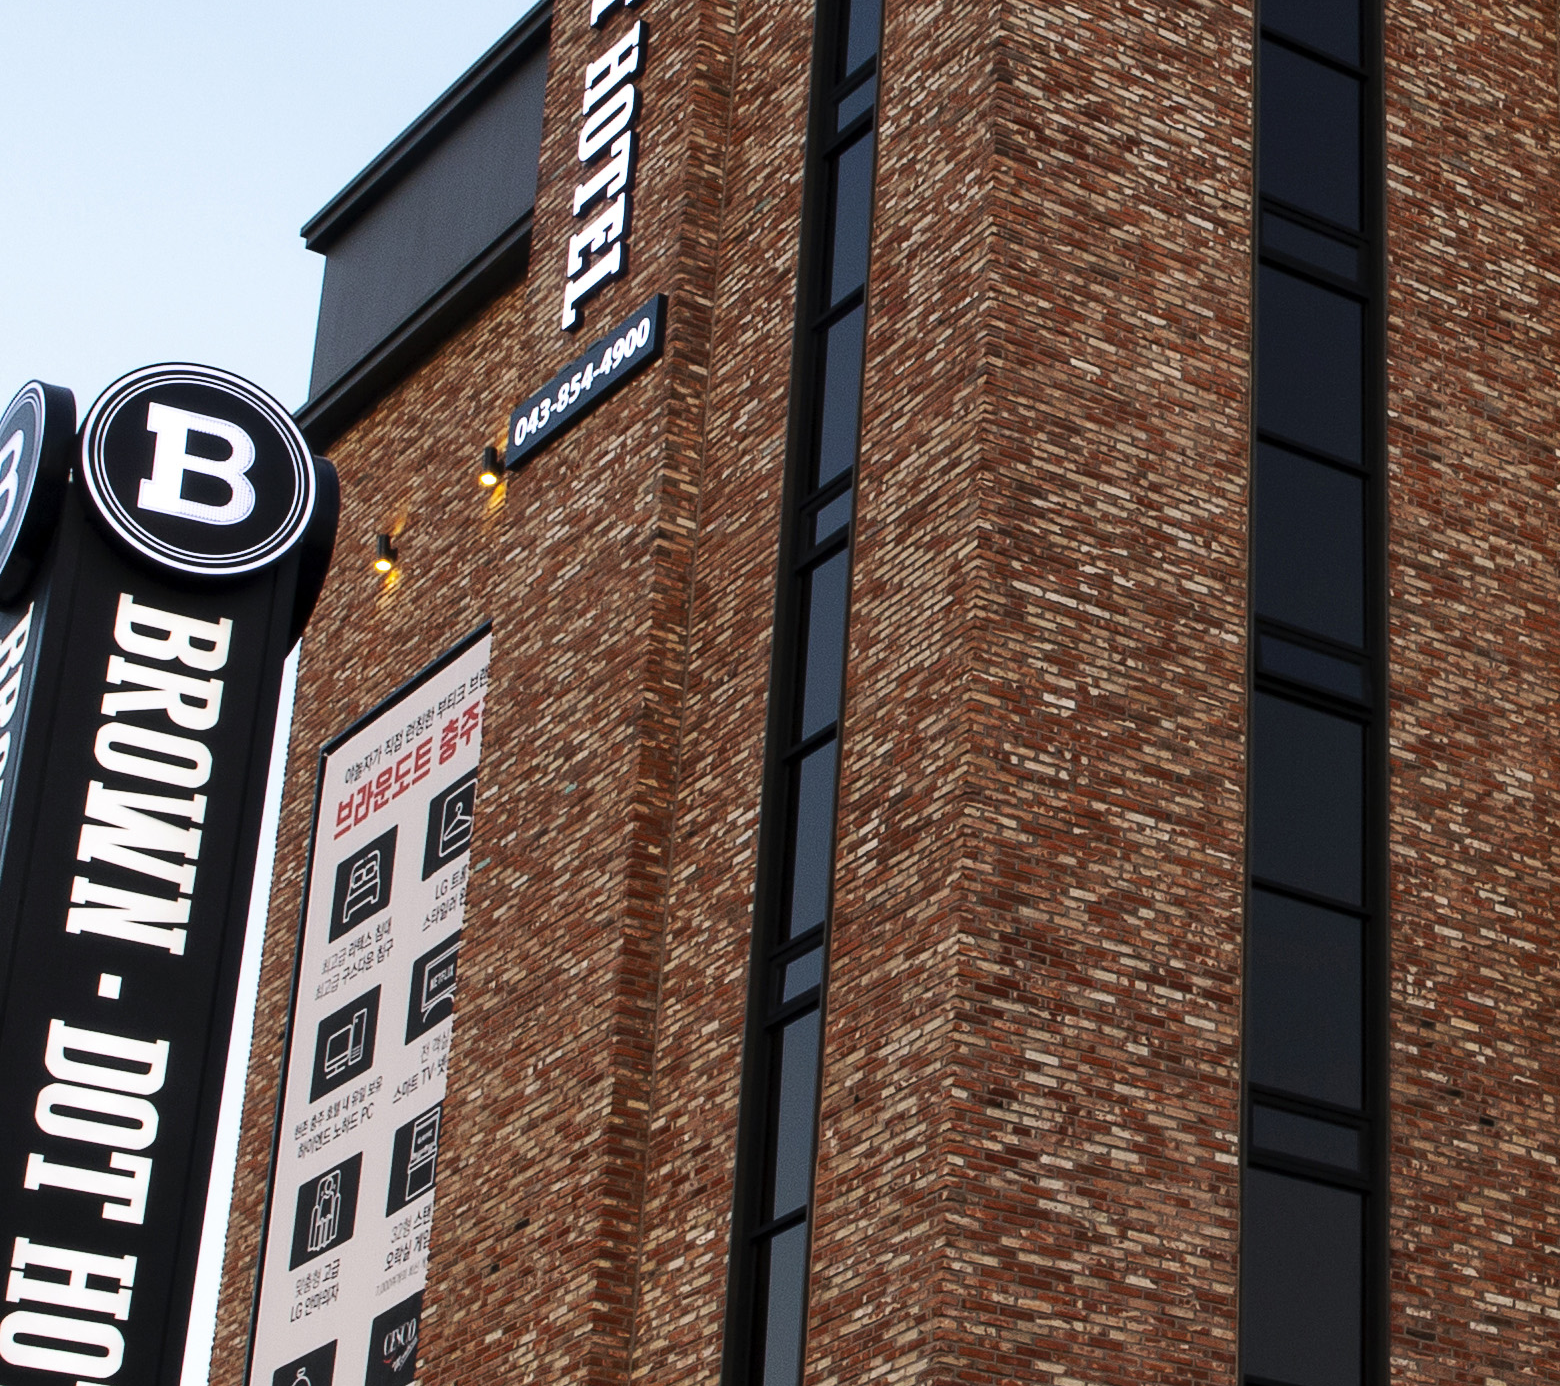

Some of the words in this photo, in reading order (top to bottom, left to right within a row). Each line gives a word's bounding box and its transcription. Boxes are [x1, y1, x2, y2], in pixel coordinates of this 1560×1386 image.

[561, 19, 642, 330] HOTEL
[514, 317, 651, 447] 043-854-4900
[137, 401, 256, 526] B
[65, 592, 233, 956] BROWN
[333, 737, 433, 841] 브라운도트
[438, 697, 486, 765] 충주
[344, 746, 382, 784] 야놀자가
[385, 730, 404, 755] 직접
[437, 683, 467, 718] 부티크
[24, 1018, 170, 1225] DOT
